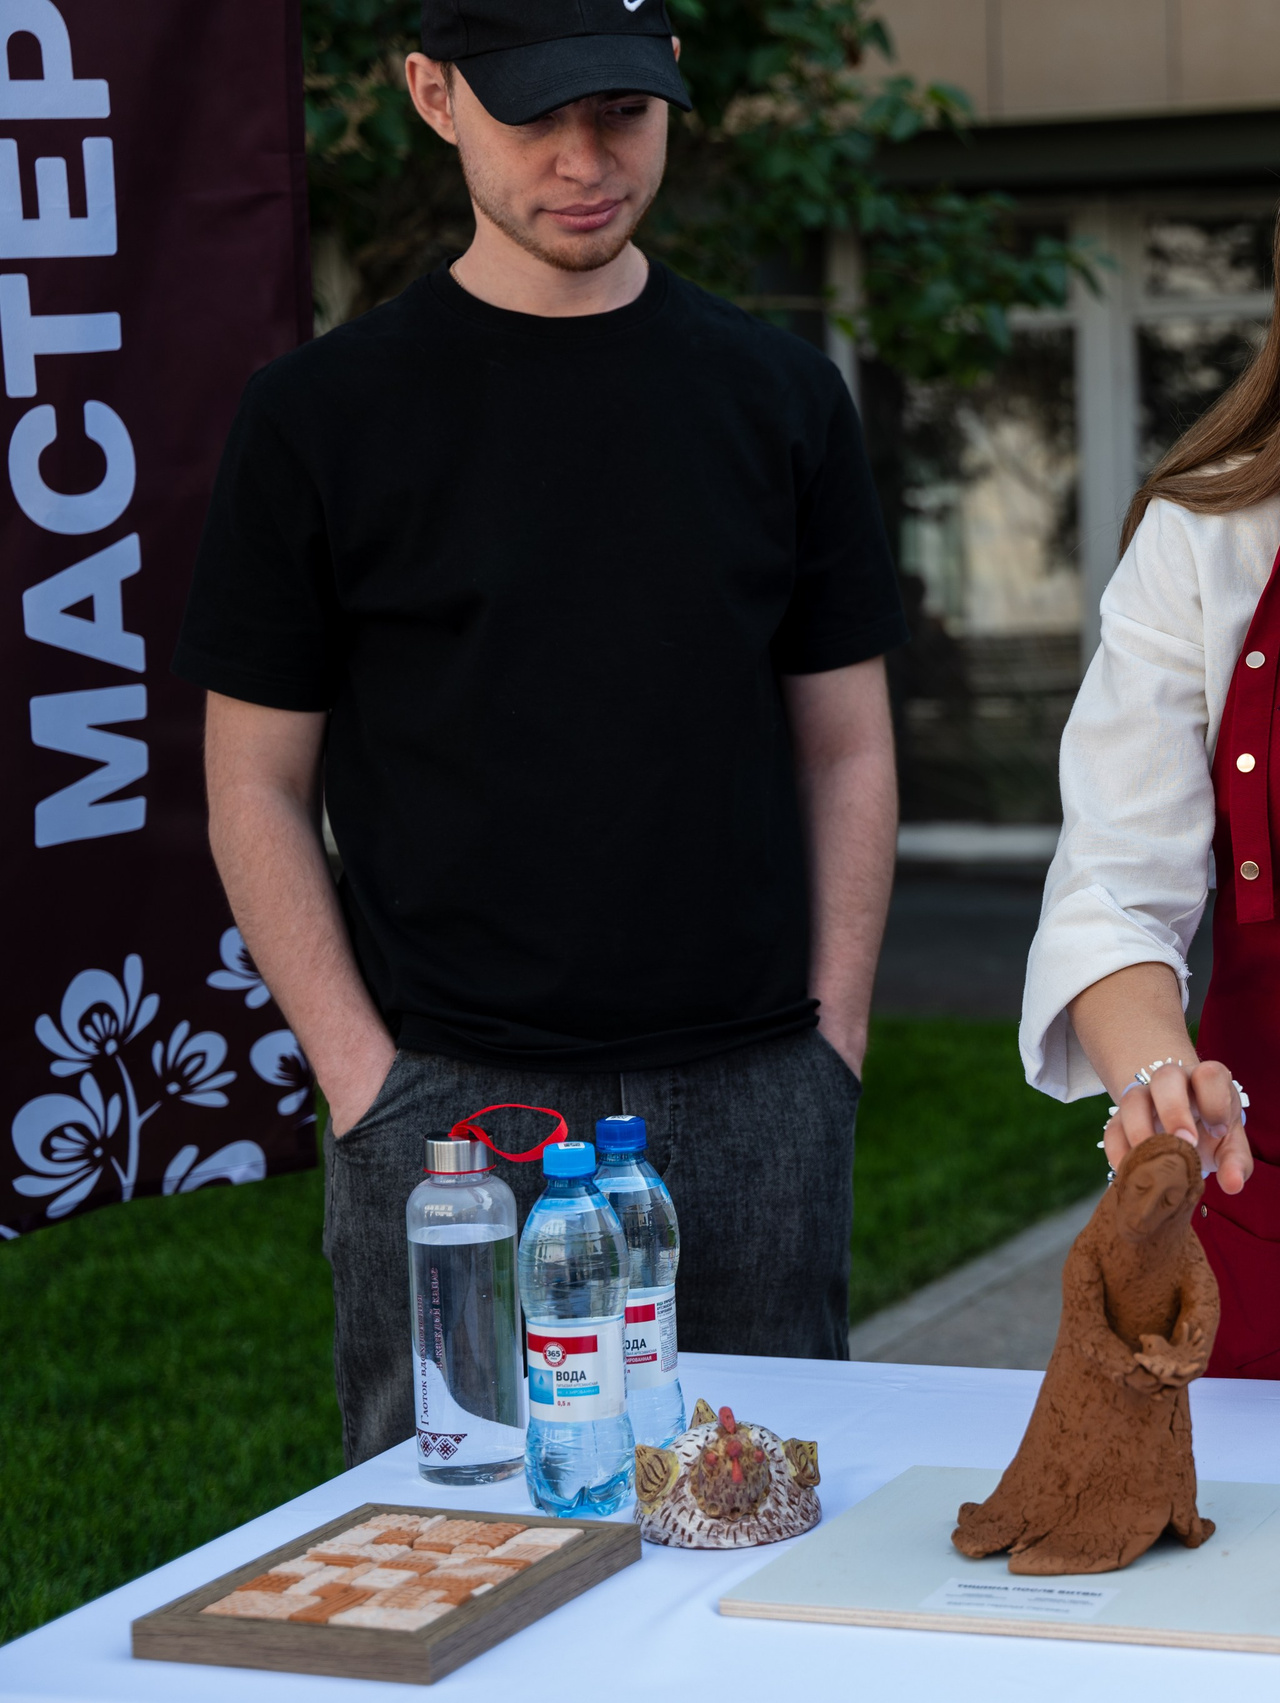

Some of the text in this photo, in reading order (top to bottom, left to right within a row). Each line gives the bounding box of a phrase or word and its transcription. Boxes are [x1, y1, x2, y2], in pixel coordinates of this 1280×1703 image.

[0, 0, 149, 848] МАСТЕР
[625, 1338, 647, 1351] ОДА
[547, 1350, 561, 1358] 365
[556, 1370, 587, 1383] ВОДА
